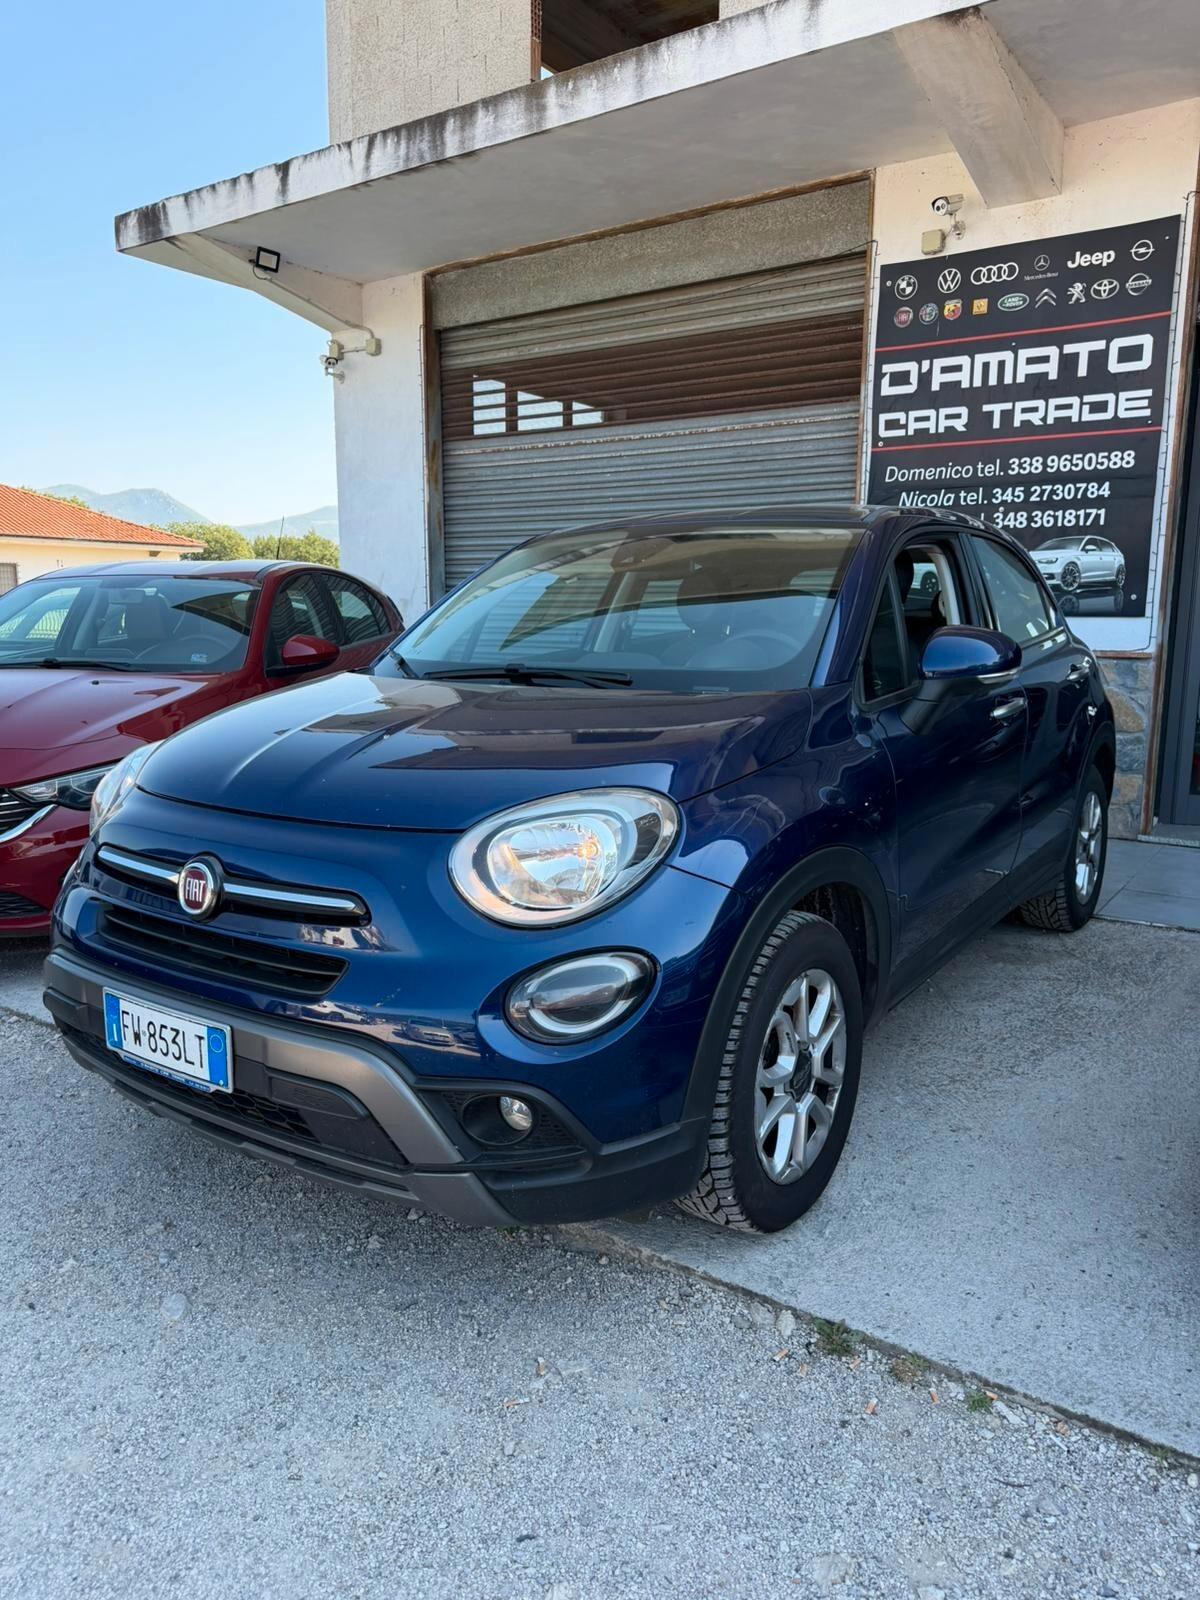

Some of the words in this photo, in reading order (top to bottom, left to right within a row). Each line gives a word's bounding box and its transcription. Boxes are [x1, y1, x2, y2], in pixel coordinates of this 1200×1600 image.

[1067, 249, 1116, 269] Jeep
[880, 333, 1154, 397] D'AMATO
[878, 406, 969, 438] CAR
[982, 388, 1153, 429] TRADE
[885, 461, 973, 482] Domenico
[977, 459, 1004, 477] tel.
[1008, 457, 1043, 475] 338
[1047, 450, 1136, 473] 9650588
[899, 490, 955, 508] Nicola
[959, 487, 988, 505] tel.
[991, 486, 1025, 504] 345
[1029, 481, 1111, 501] 2730784
[993, 511, 1028, 529] 348
[1030, 508, 1106, 528] 3618171
[185, 877, 206, 903] FIAT
